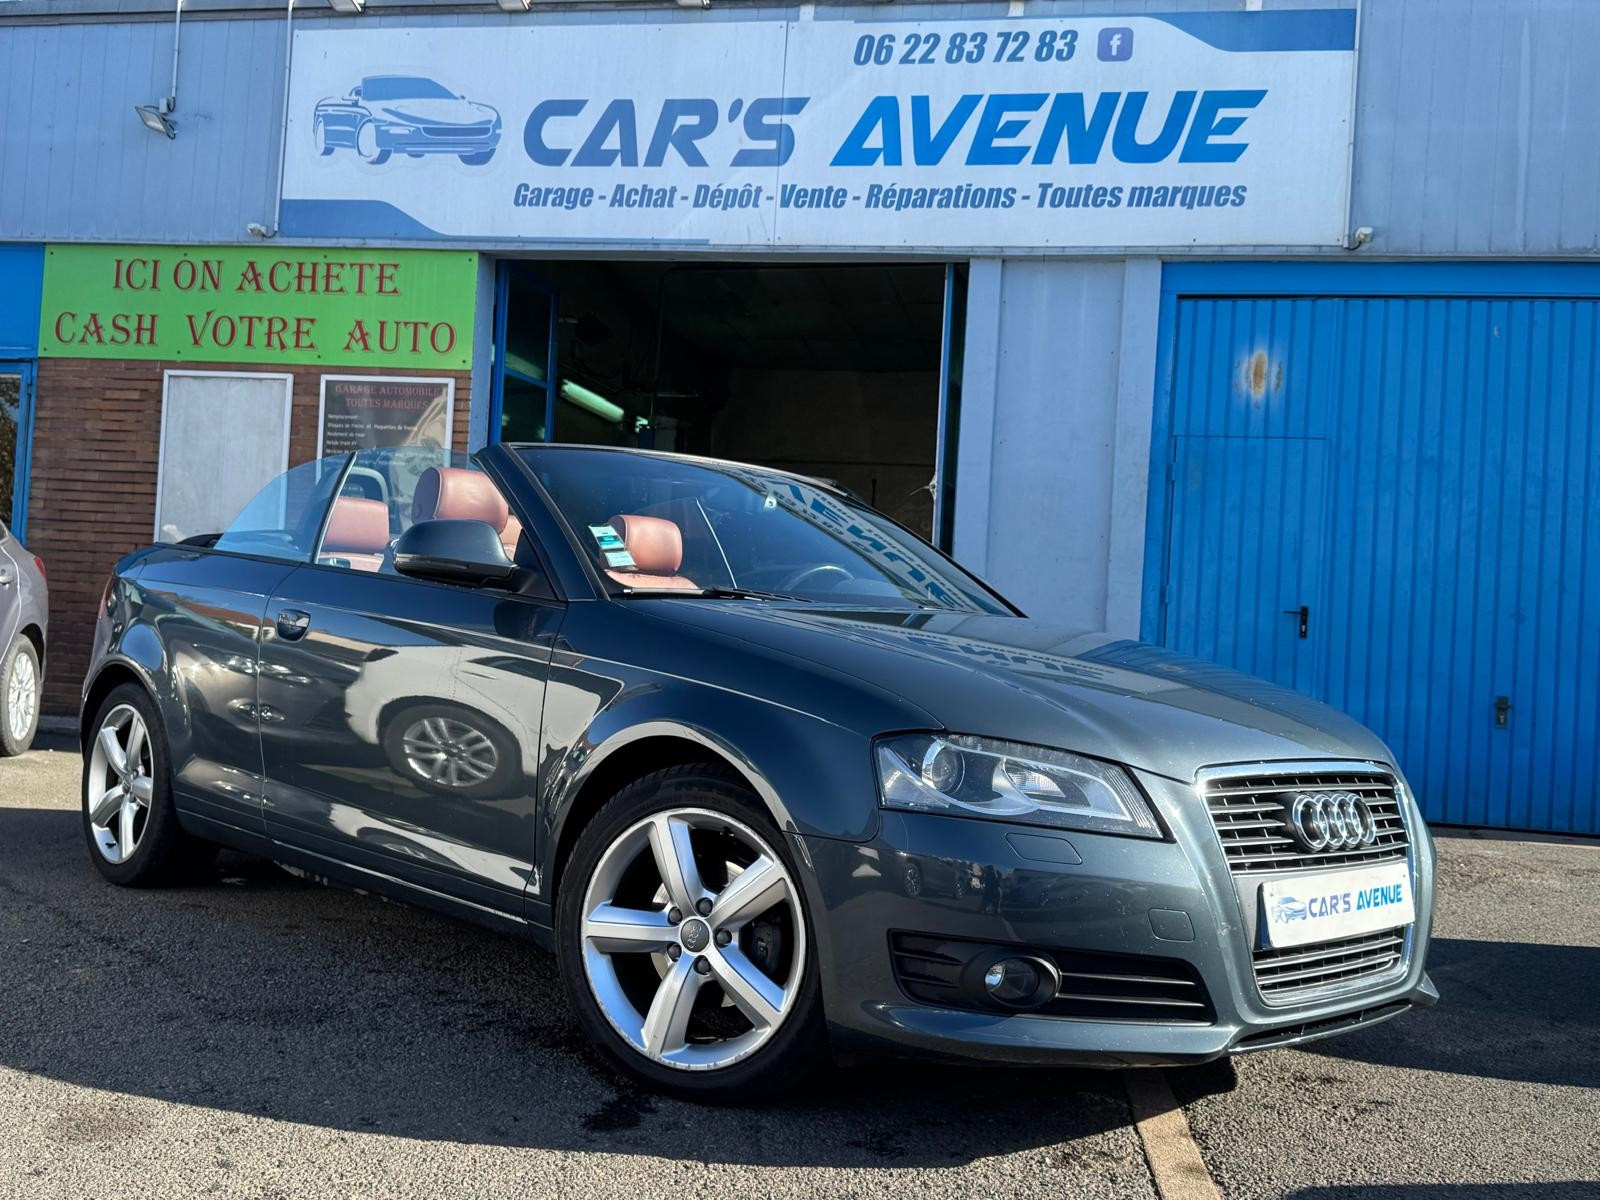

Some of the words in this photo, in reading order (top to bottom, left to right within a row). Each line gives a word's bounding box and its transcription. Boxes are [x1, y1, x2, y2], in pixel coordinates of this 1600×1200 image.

[853, 34, 895, 66] 06
[899, 33, 938, 65] 22
[944, 32, 988, 64] 83
[992, 31, 1030, 63] 72
[1033, 29, 1078, 62] 83
[523, 97, 811, 167] CAR'S
[829, 89, 1269, 167] AVENUE
[513, 182, 594, 210] Garage
[609, 184, 677, 209] Achat
[692, 182, 762, 211] Dépôt
[779, 184, 847, 209] Vente
[864, 182, 1017, 211] Réparations
[1036, 182, 1122, 209] Toutes
[1127, 184, 1247, 211] marques
[113, 258, 160, 291] ICI
[173, 258, 224, 292] ON
[235, 260, 401, 296] ACHETE
[54, 311, 159, 346] CASH
[185, 309, 318, 352] VOTRE
[343, 318, 456, 355] AUTO
[335, 384, 376, 394] GARAGE
[379, 386, 441, 396] AUTOMOBILE
[345, 398, 380, 408] TOUTES
[382, 399, 430, 410] MARQUES
[1308, 892, 1351, 918] CAR'S
[1356, 883, 1403, 911] AVENUE
